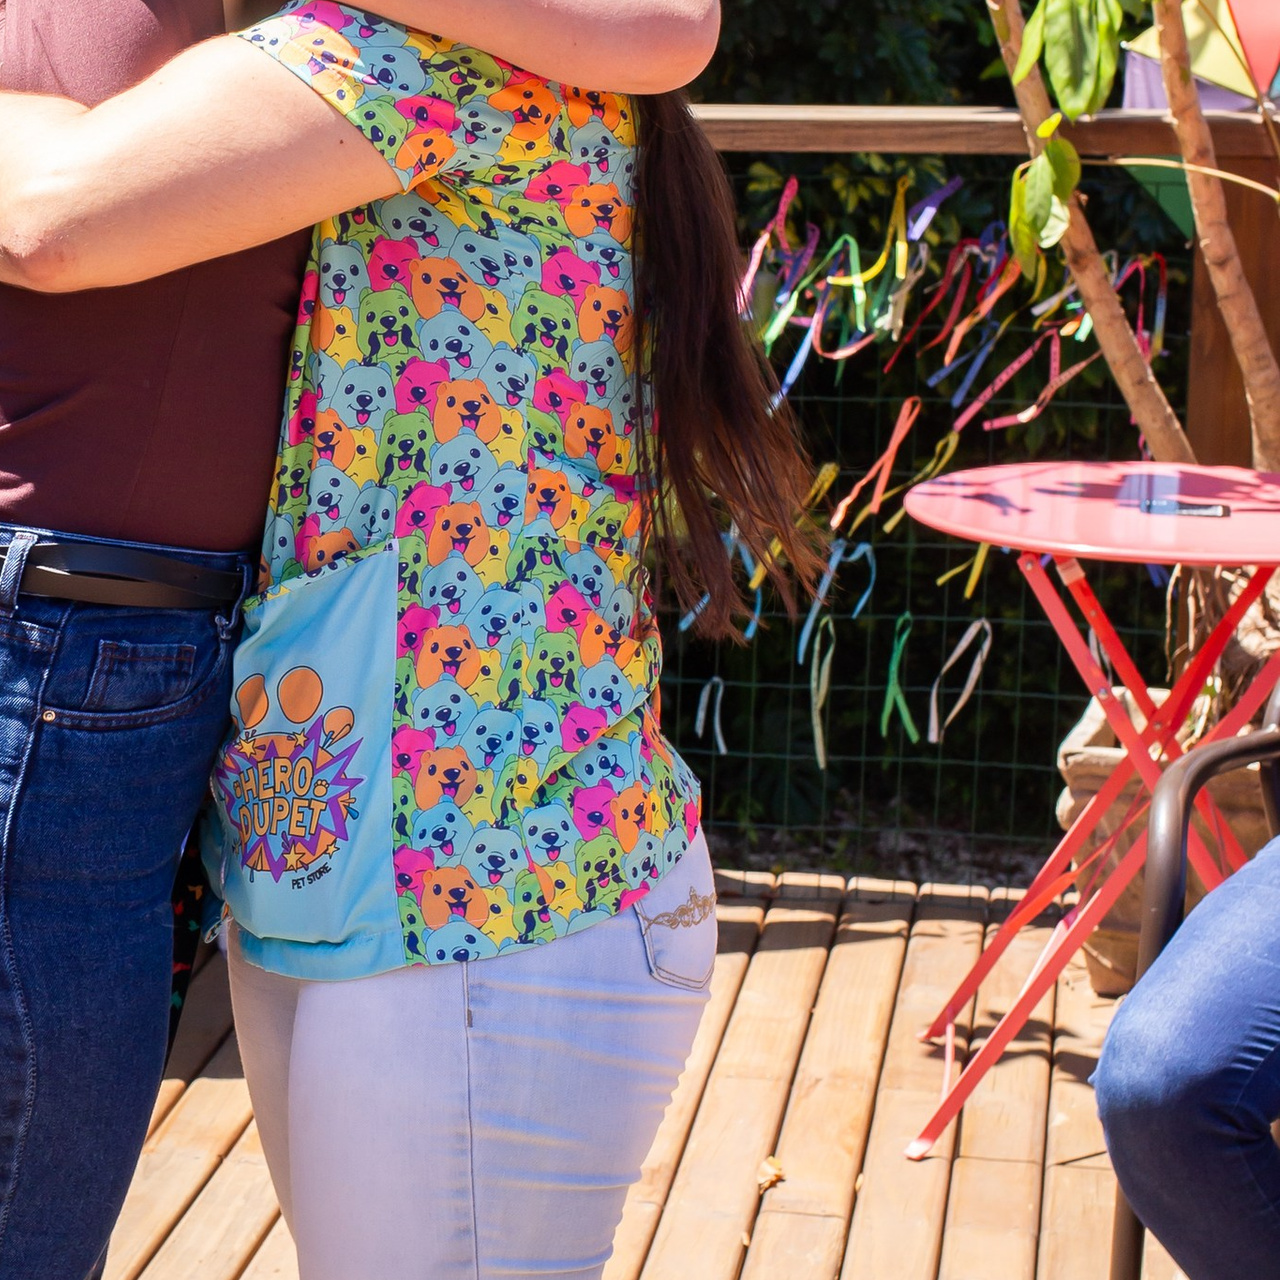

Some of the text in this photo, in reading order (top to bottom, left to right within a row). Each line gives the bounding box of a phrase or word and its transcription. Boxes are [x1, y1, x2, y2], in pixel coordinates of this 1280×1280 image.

[238, 756, 315, 804] HERO
[291, 862, 332, 890] PET STORE
